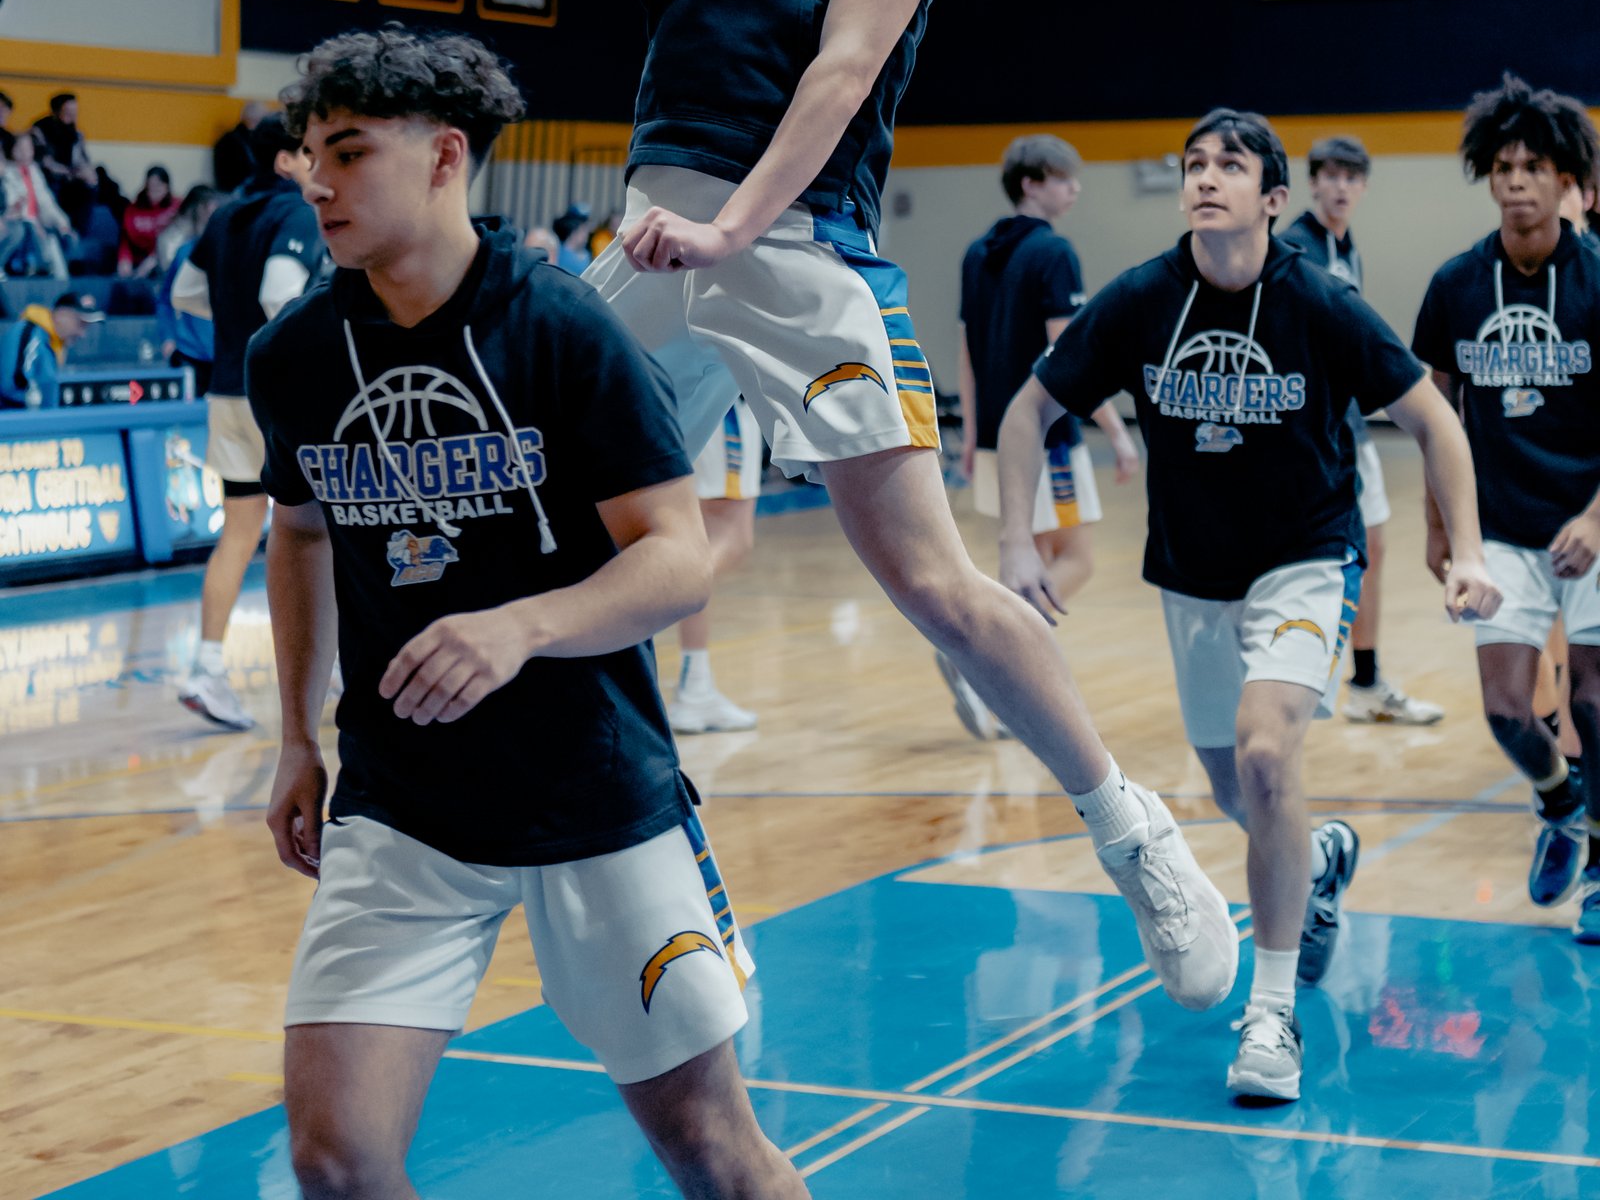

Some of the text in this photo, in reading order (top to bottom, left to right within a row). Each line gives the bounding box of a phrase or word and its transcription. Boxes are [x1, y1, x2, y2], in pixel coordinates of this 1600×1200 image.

[1456, 339, 1592, 374] CHARGERS
[1143, 363, 1305, 411] CHARGERS
[1472, 373, 1573, 387] BASKETBALL
[1159, 402, 1282, 425] BASKETBALL
[297, 427, 546, 501] CHARGERS
[331, 494, 513, 526] BASKETBALL
